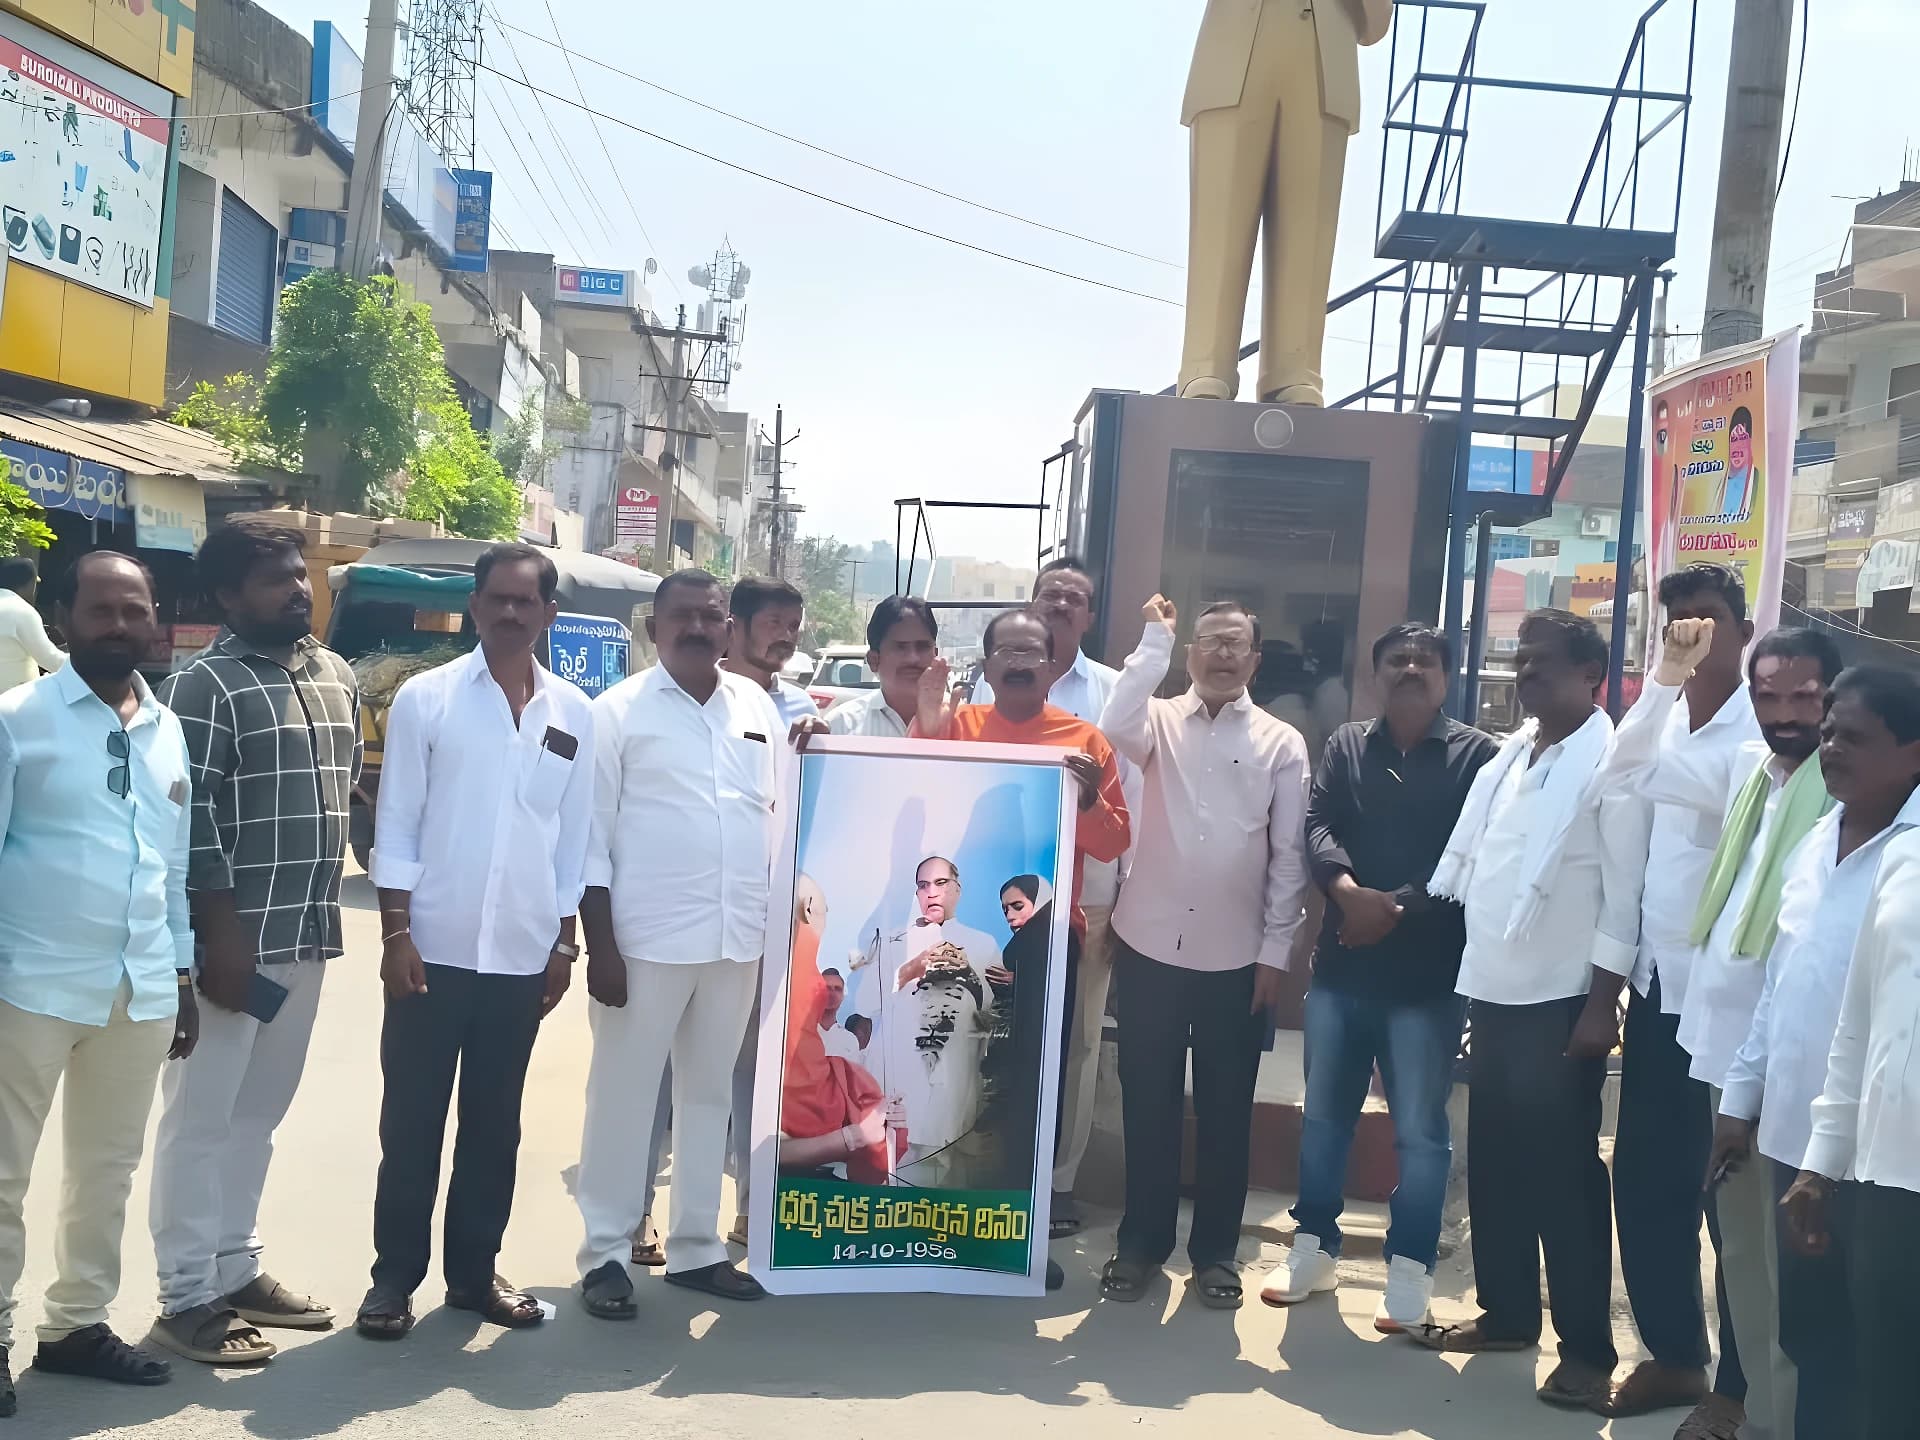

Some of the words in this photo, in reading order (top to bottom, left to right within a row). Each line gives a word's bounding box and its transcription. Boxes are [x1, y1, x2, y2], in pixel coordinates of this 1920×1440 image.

[778, 1190, 822, 1239] ధర్మ
[823, 1194, 870, 1234] చక్ర
[874, 1197, 969, 1242] పరివర్తన
[974, 1203, 1028, 1241] దినం
[832, 1242, 958, 1261] 14-10-1956
